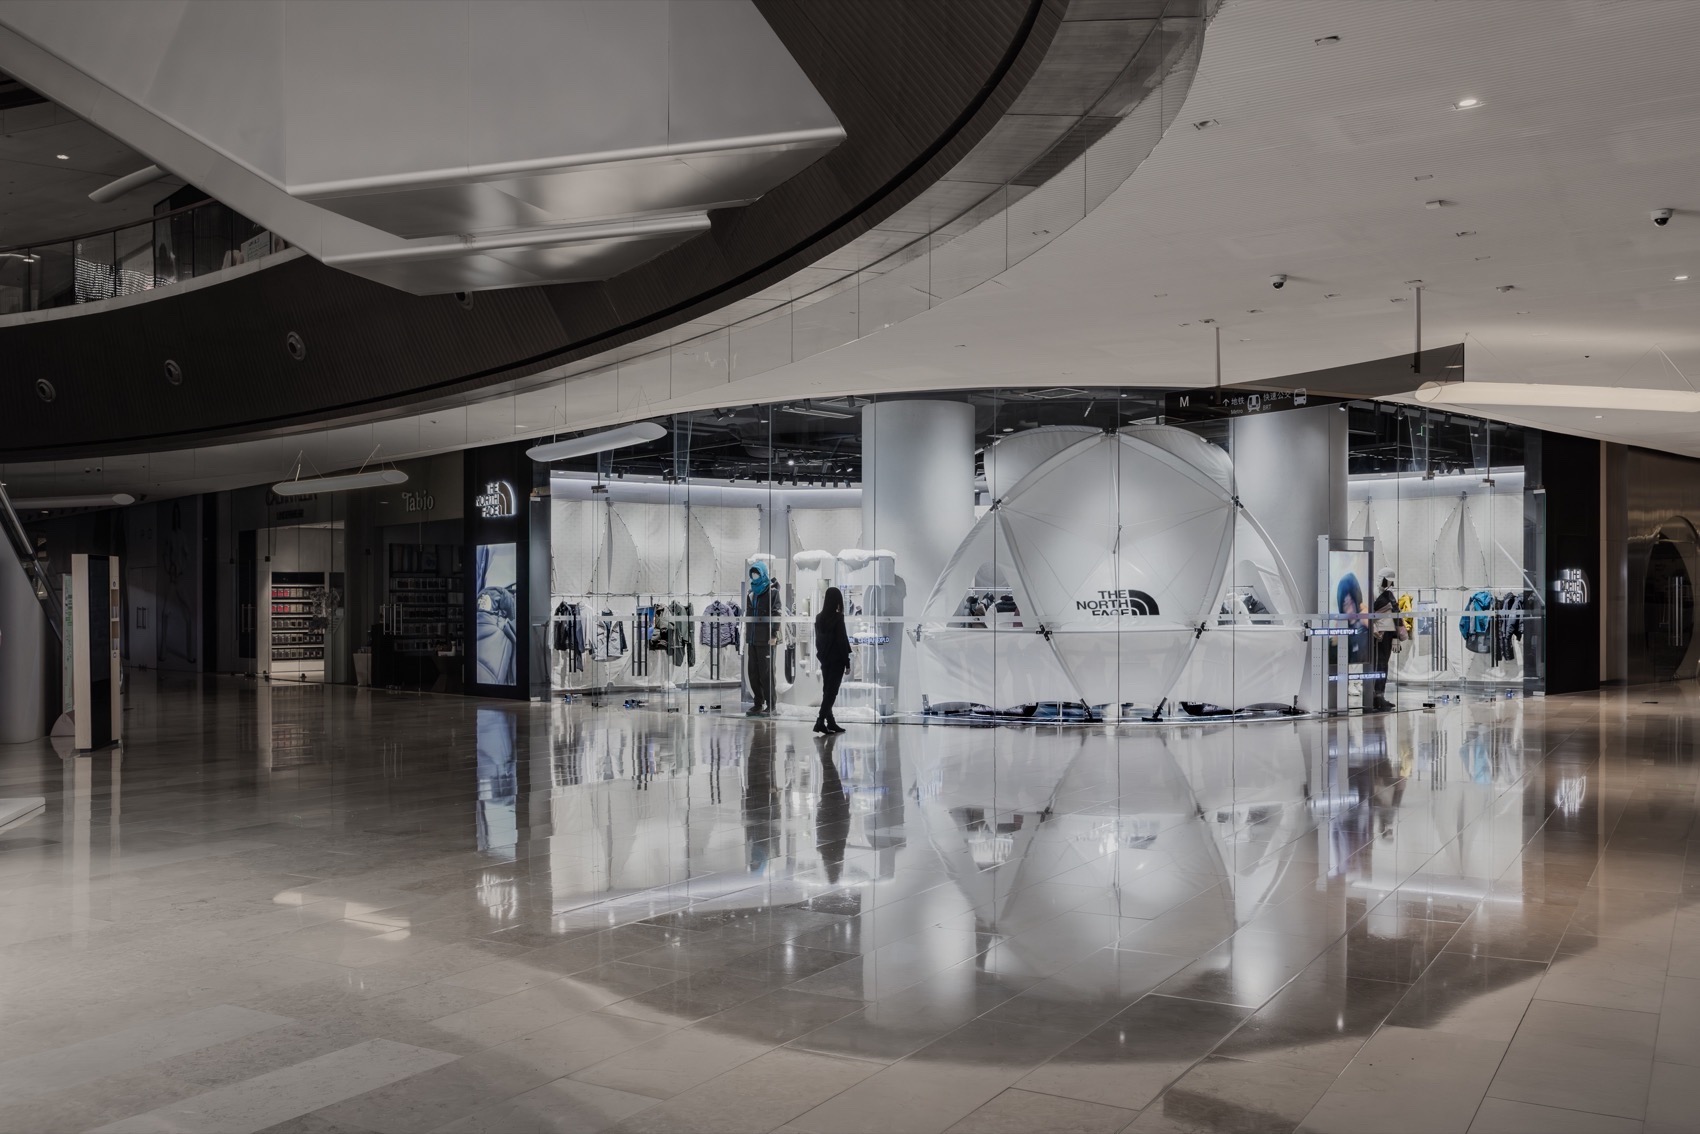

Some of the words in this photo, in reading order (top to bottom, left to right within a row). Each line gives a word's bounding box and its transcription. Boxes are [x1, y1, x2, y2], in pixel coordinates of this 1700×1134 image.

[1179, 395, 1190, 408] M
[1231, 396, 1245, 406] 地铁
[1263, 390, 1291, 402] 快速公交
[485, 481, 499, 494] THE
[401, 489, 434, 512] Tabio
[476, 493, 500, 506] NORTH
[482, 504, 500, 517] FACE
[1098, 590, 1127, 599] THE
[1076, 599, 1129, 610] NORTH
